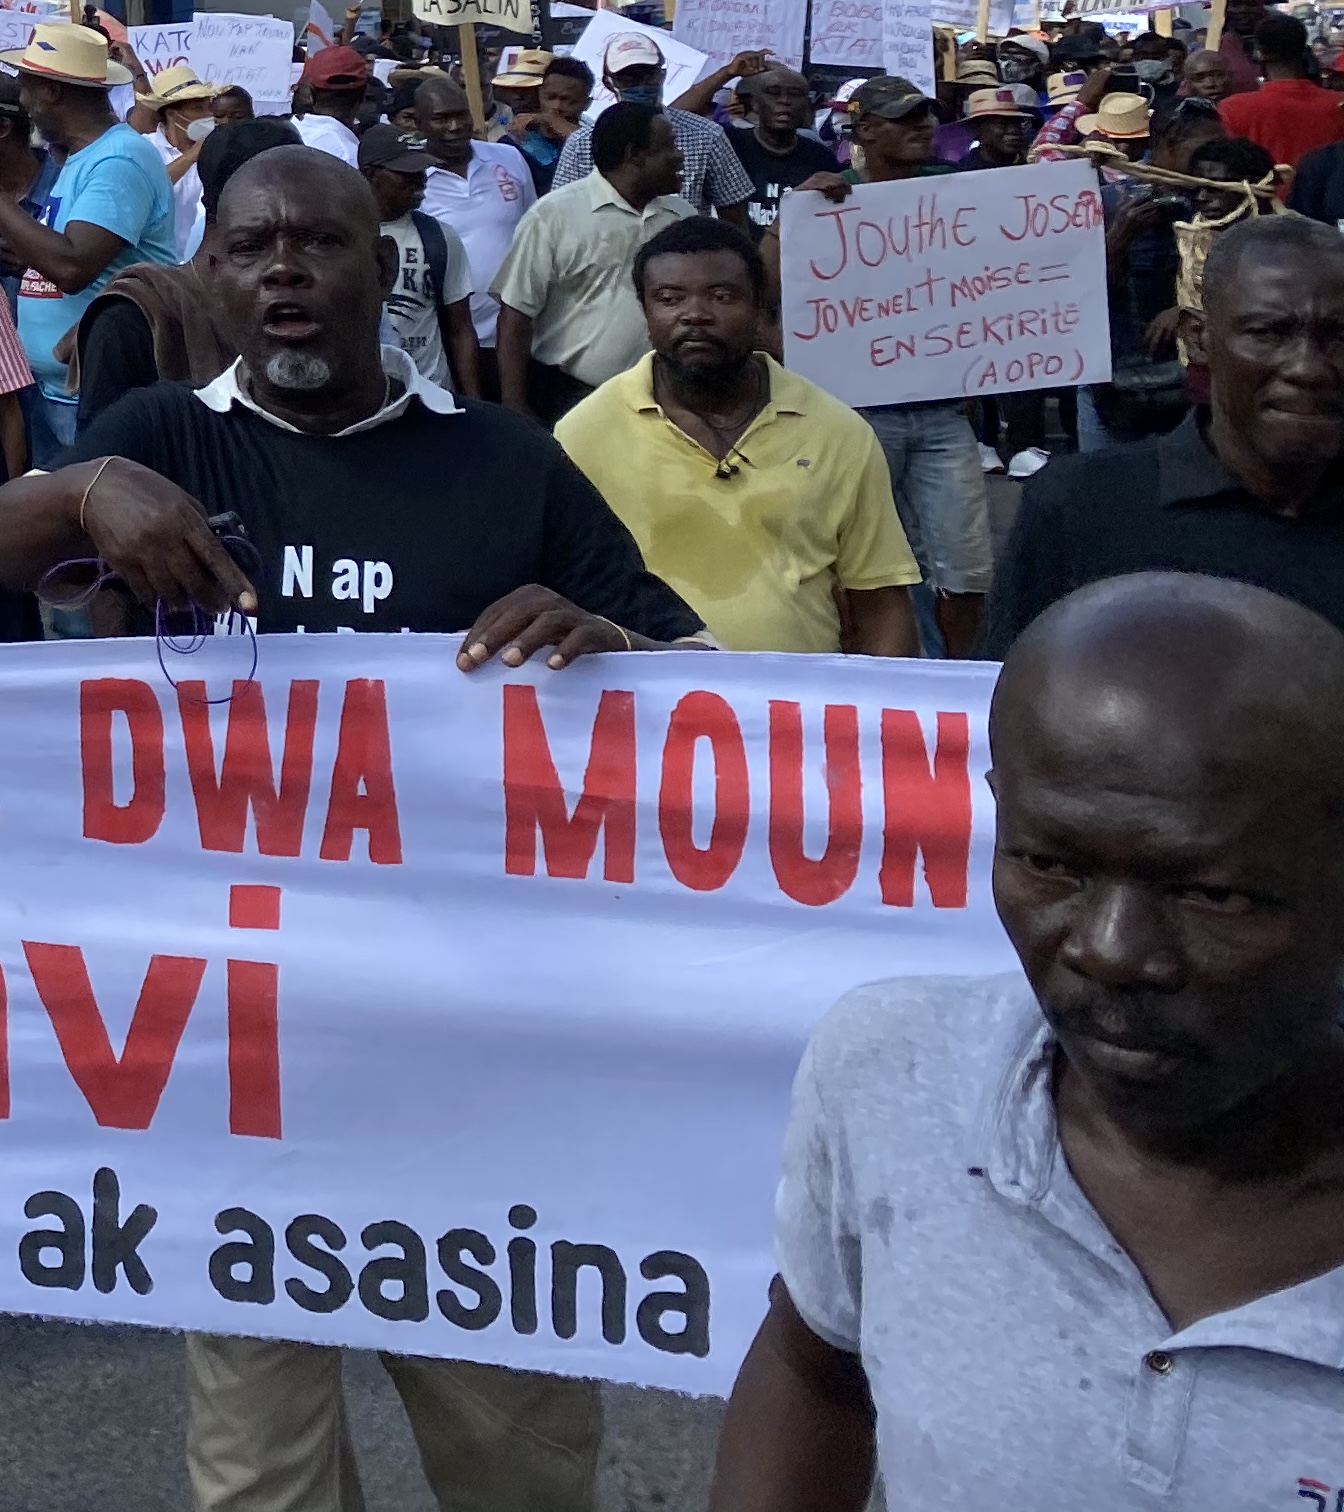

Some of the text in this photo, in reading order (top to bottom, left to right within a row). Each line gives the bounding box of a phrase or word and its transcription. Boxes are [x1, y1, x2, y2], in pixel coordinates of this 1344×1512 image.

[78, 677, 403, 865] DWA
[502, 684, 970, 909] MOUN
[18, 1165, 159, 1295] ak
[208, 1203, 710, 1358] asasina
